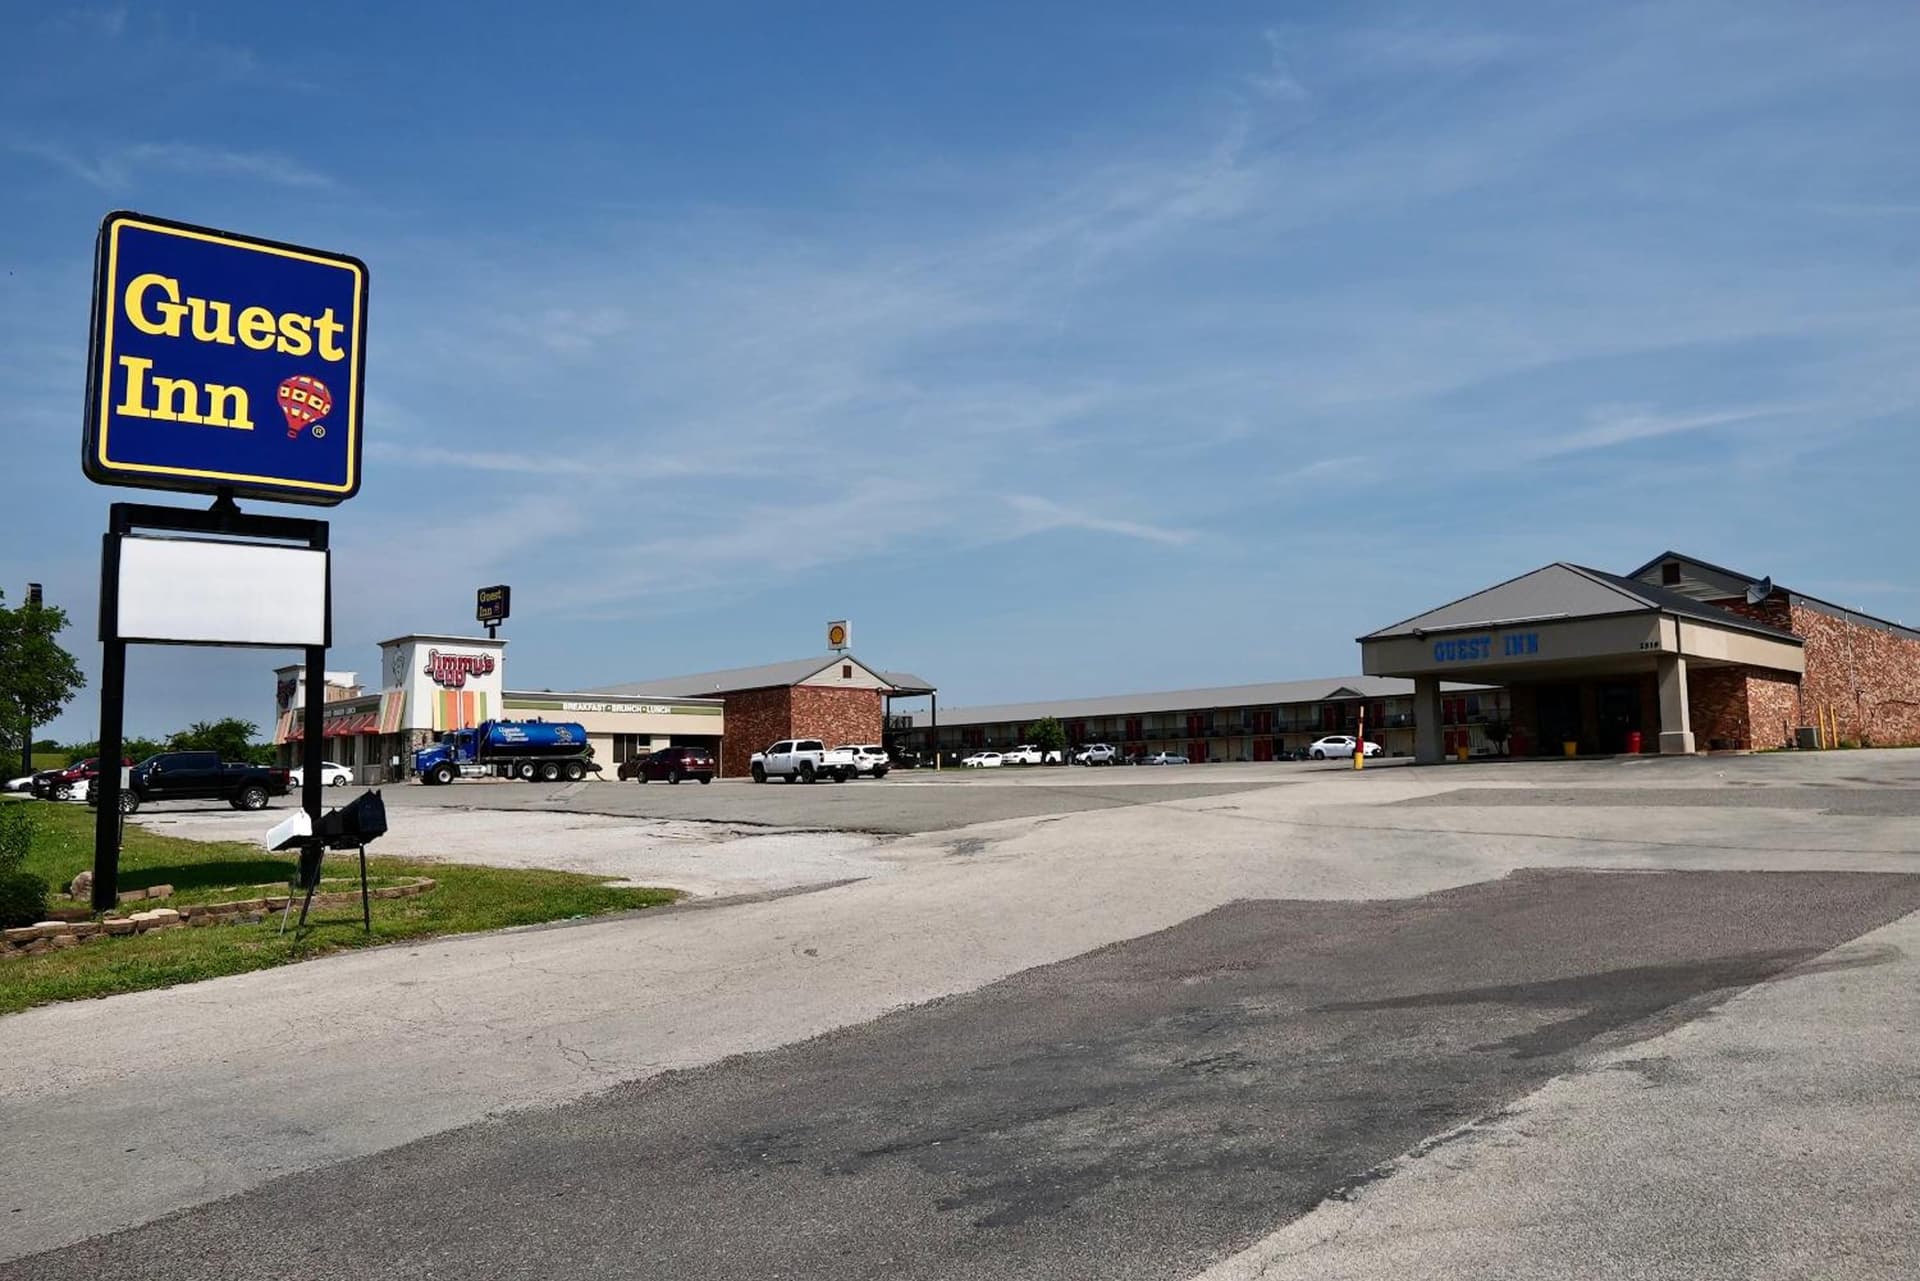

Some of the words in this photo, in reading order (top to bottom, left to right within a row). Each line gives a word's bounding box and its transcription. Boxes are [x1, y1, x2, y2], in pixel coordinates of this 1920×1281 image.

[124, 273, 345, 362] Guest
[116, 355, 254, 430] Inn
[1434, 635, 1491, 662] GUEST
[1504, 632, 1538, 656] INN
[562, 702, 605, 712] BREAKFAST
[611, 703, 641, 713] BRUNCH
[647, 704, 671, 714] LUNCH
